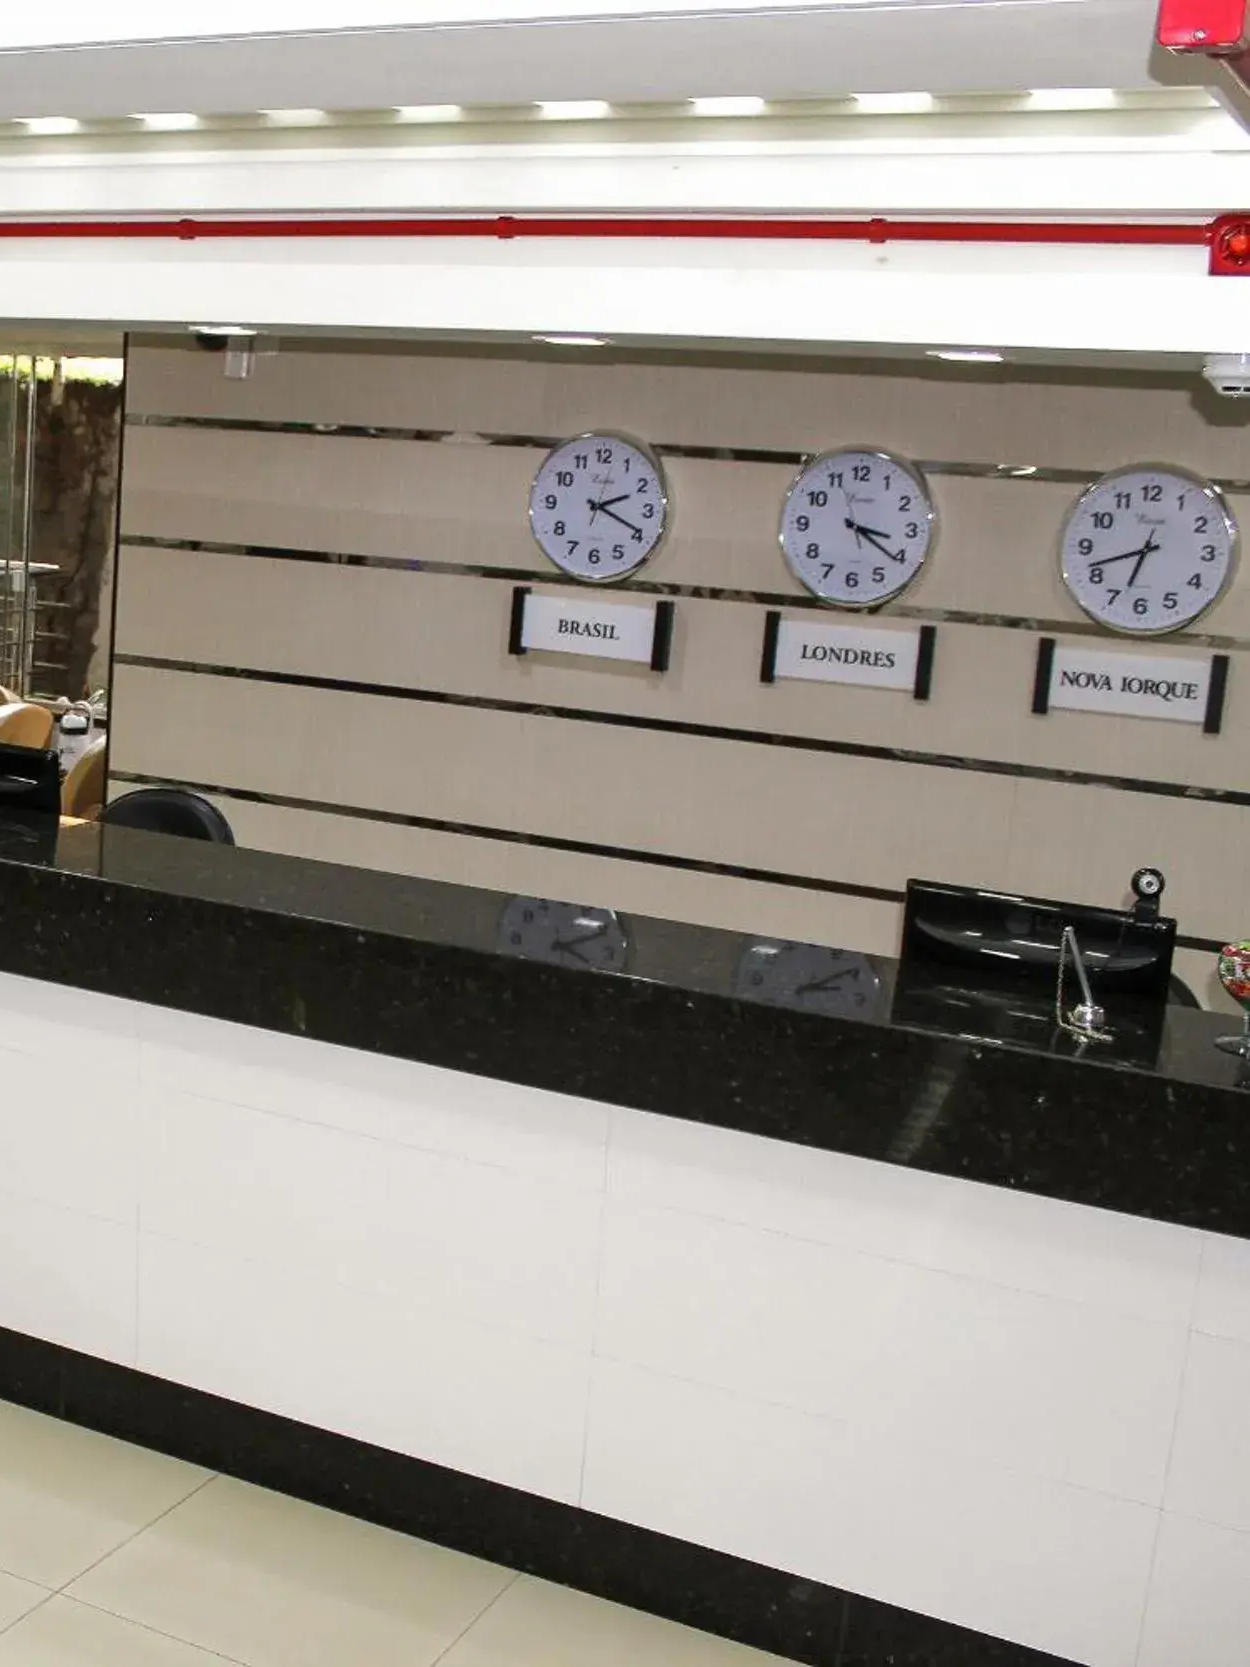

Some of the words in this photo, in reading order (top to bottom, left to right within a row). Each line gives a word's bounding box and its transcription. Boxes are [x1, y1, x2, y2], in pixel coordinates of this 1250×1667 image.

[574, 454, 589, 469] 11
[595, 449, 613, 464] 12
[623, 458, 631, 473] 1
[556, 471, 575, 487] 10
[828, 473, 844, 489] 11
[852, 466, 871, 482] 12
[637, 478, 649, 493] 2
[883, 476, 891, 491] 1
[807, 491, 828, 507] 10
[1114, 493, 1132, 510] 11
[1141, 485, 1163, 502] 12
[545, 495, 558, 510] 9
[898, 496, 911, 512] 2
[1177, 494, 1185, 511] 1
[642, 504, 654, 518] 3
[553, 521, 566, 536] 8
[796, 516, 809, 532] 9
[1090, 512, 1113, 530] 10
[1194, 517, 1208, 533] 2
[905, 523, 918, 538] 3
[566, 541, 579, 556] 7
[612, 545, 625, 560] 5
[806, 544, 820, 560] 8
[1078, 538, 1093, 556] 9
[1201, 545, 1216, 562] 3
[589, 549, 600, 564] 6
[821, 563, 834, 580] 7
[872, 567, 885, 583] 5
[1089, 567, 1103, 584] 8
[845, 572, 859, 588] 6
[1186, 573, 1201, 590] 4
[1106, 589, 1122, 606] 7
[1163, 593, 1178, 609] 5
[1133, 598, 1147, 615] 6
[557, 618, 620, 640] BRASIL
[801, 644, 896, 668] LONDRES
[1060, 670, 1113, 691] NOVA
[1120, 676, 1199, 701] IORQUE
